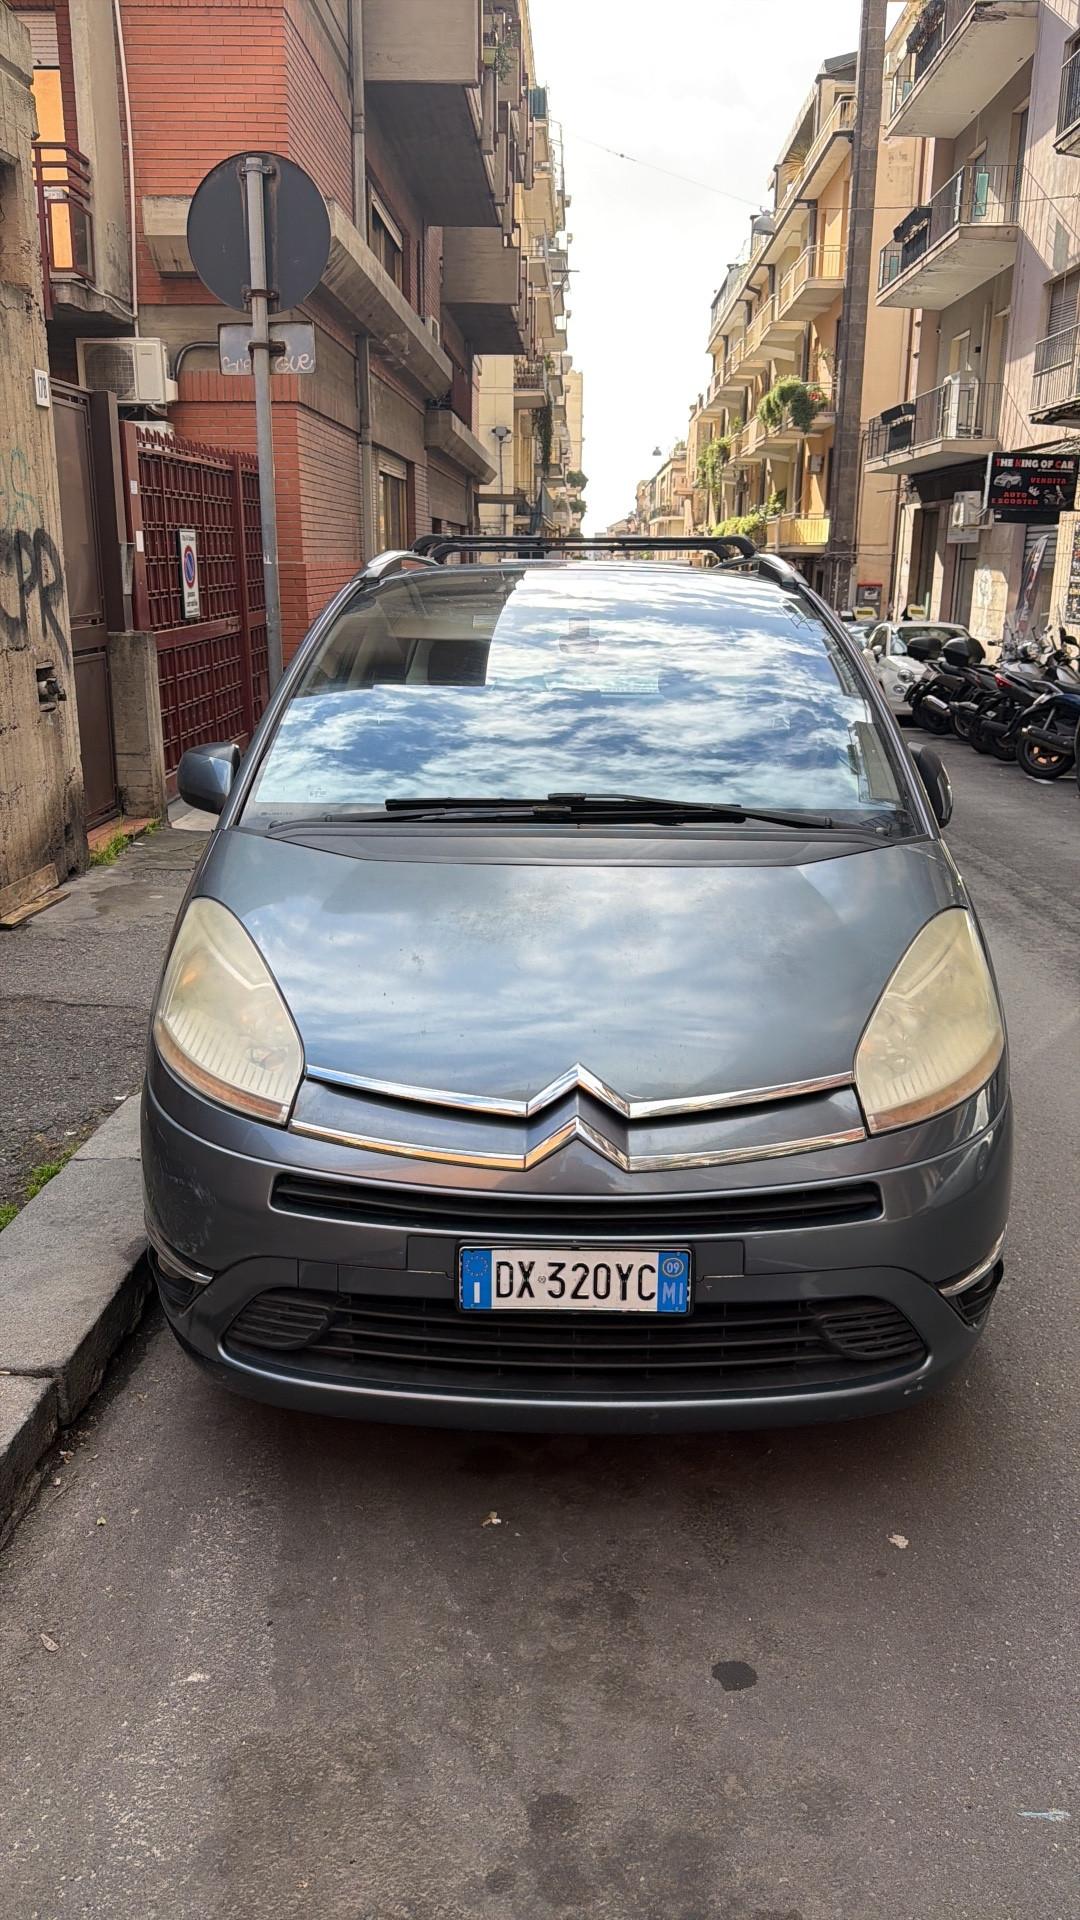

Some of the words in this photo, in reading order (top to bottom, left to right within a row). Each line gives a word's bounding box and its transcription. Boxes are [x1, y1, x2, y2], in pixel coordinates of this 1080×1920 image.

[995, 458, 1014, 468] THE
[1015, 458, 1039, 468] KING
[1041, 460, 1054, 469] OF
[1055, 460, 1075, 469] CAR
[666, 1262, 680, 1274] 09
[662, 1281, 684, 1305] MI
